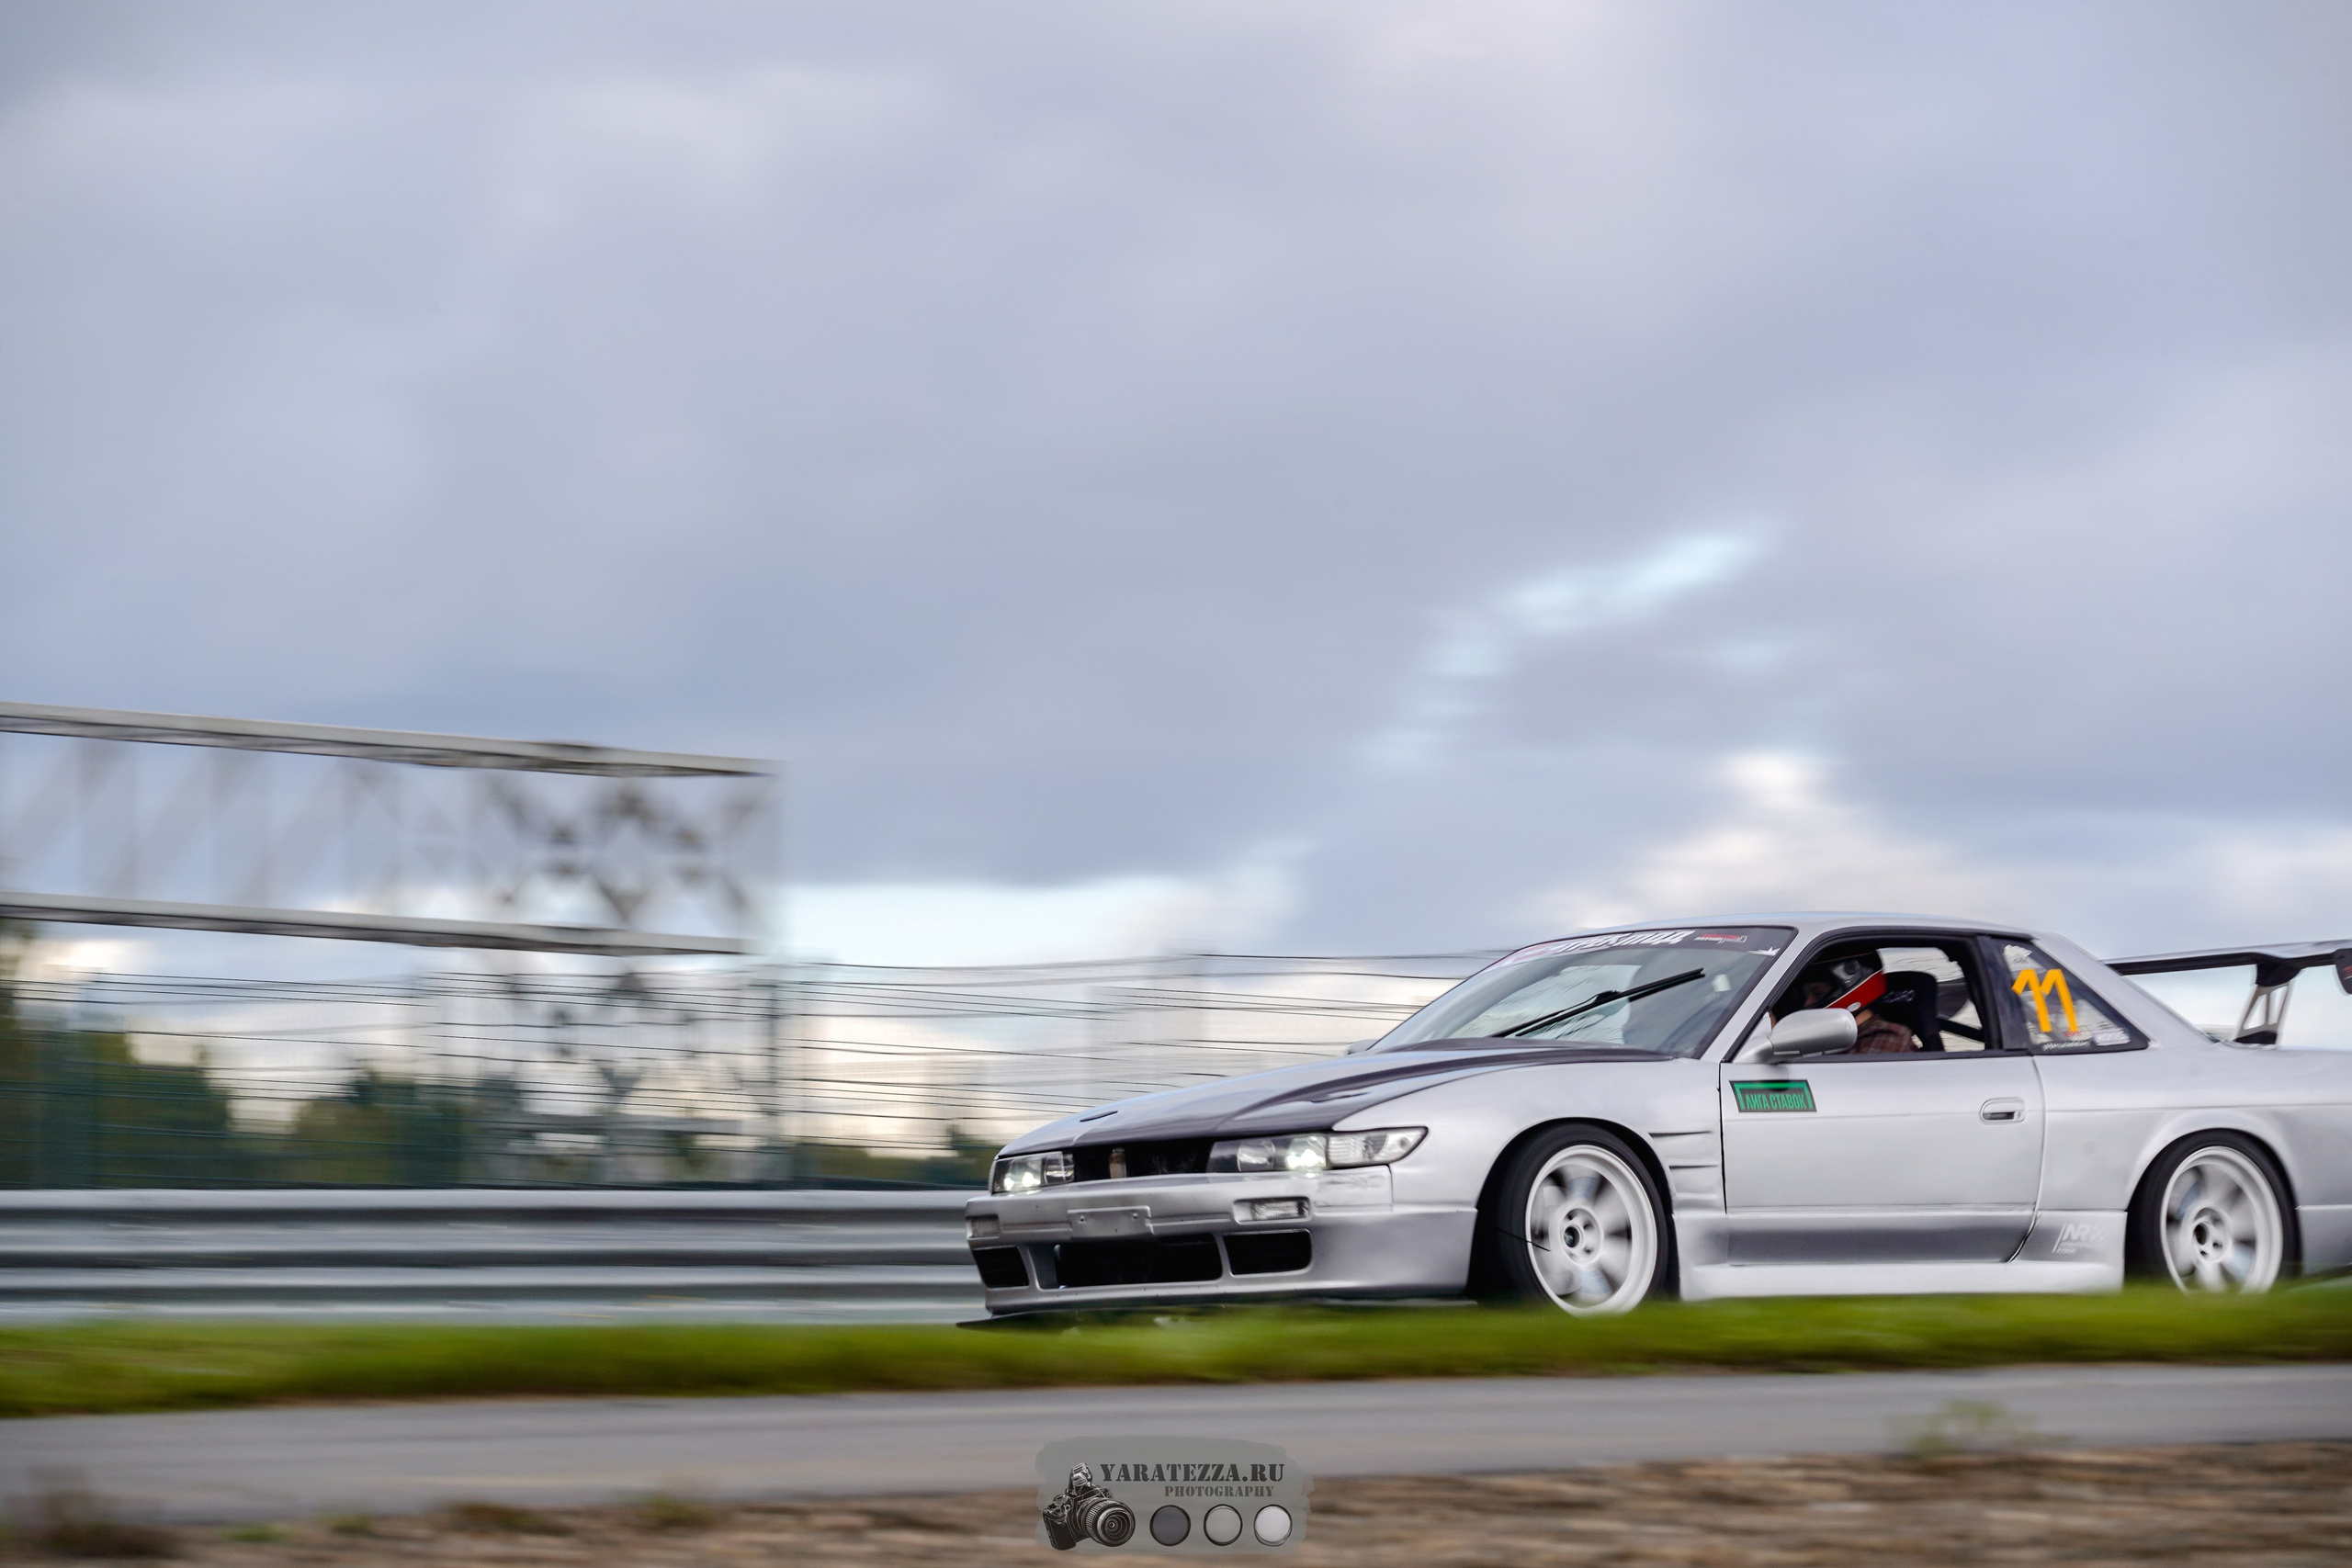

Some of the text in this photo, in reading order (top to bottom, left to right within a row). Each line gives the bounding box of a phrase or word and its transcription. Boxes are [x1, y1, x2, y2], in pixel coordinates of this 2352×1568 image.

[2011, 968, 2080, 1033] 11
[1745, 1093, 1807, 1111] ЛИГА СТАВОК
